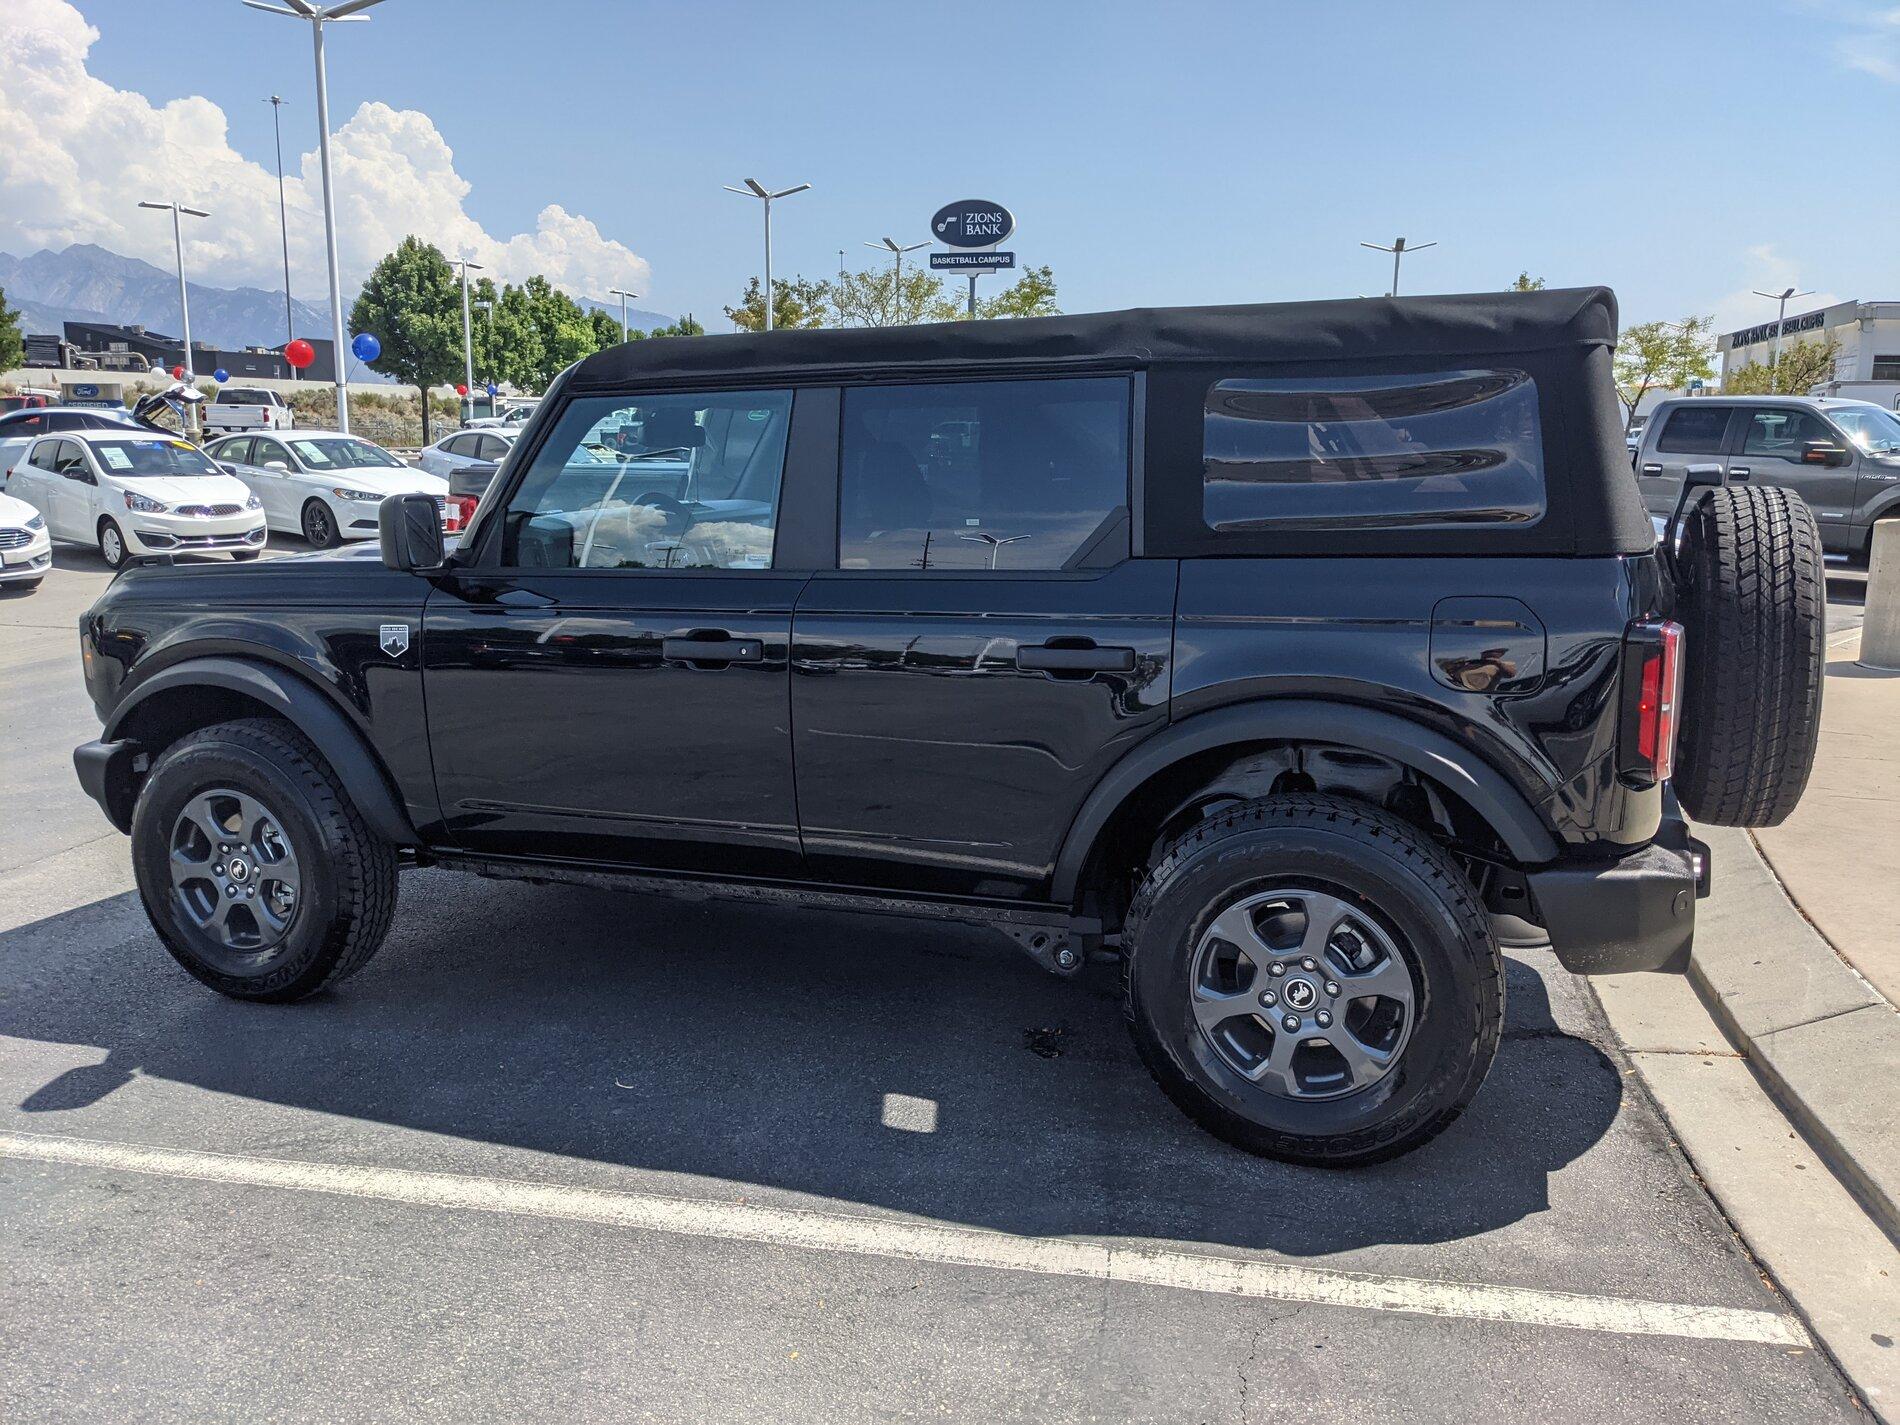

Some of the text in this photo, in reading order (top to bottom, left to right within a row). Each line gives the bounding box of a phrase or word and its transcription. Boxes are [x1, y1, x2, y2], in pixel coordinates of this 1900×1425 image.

[965, 212, 1002, 223] ZIONS
[966, 224, 1002, 235] BANK
[932, 255, 1010, 265] BASKETBALL CAMPUS
[76, 386, 92, 395] Ford
